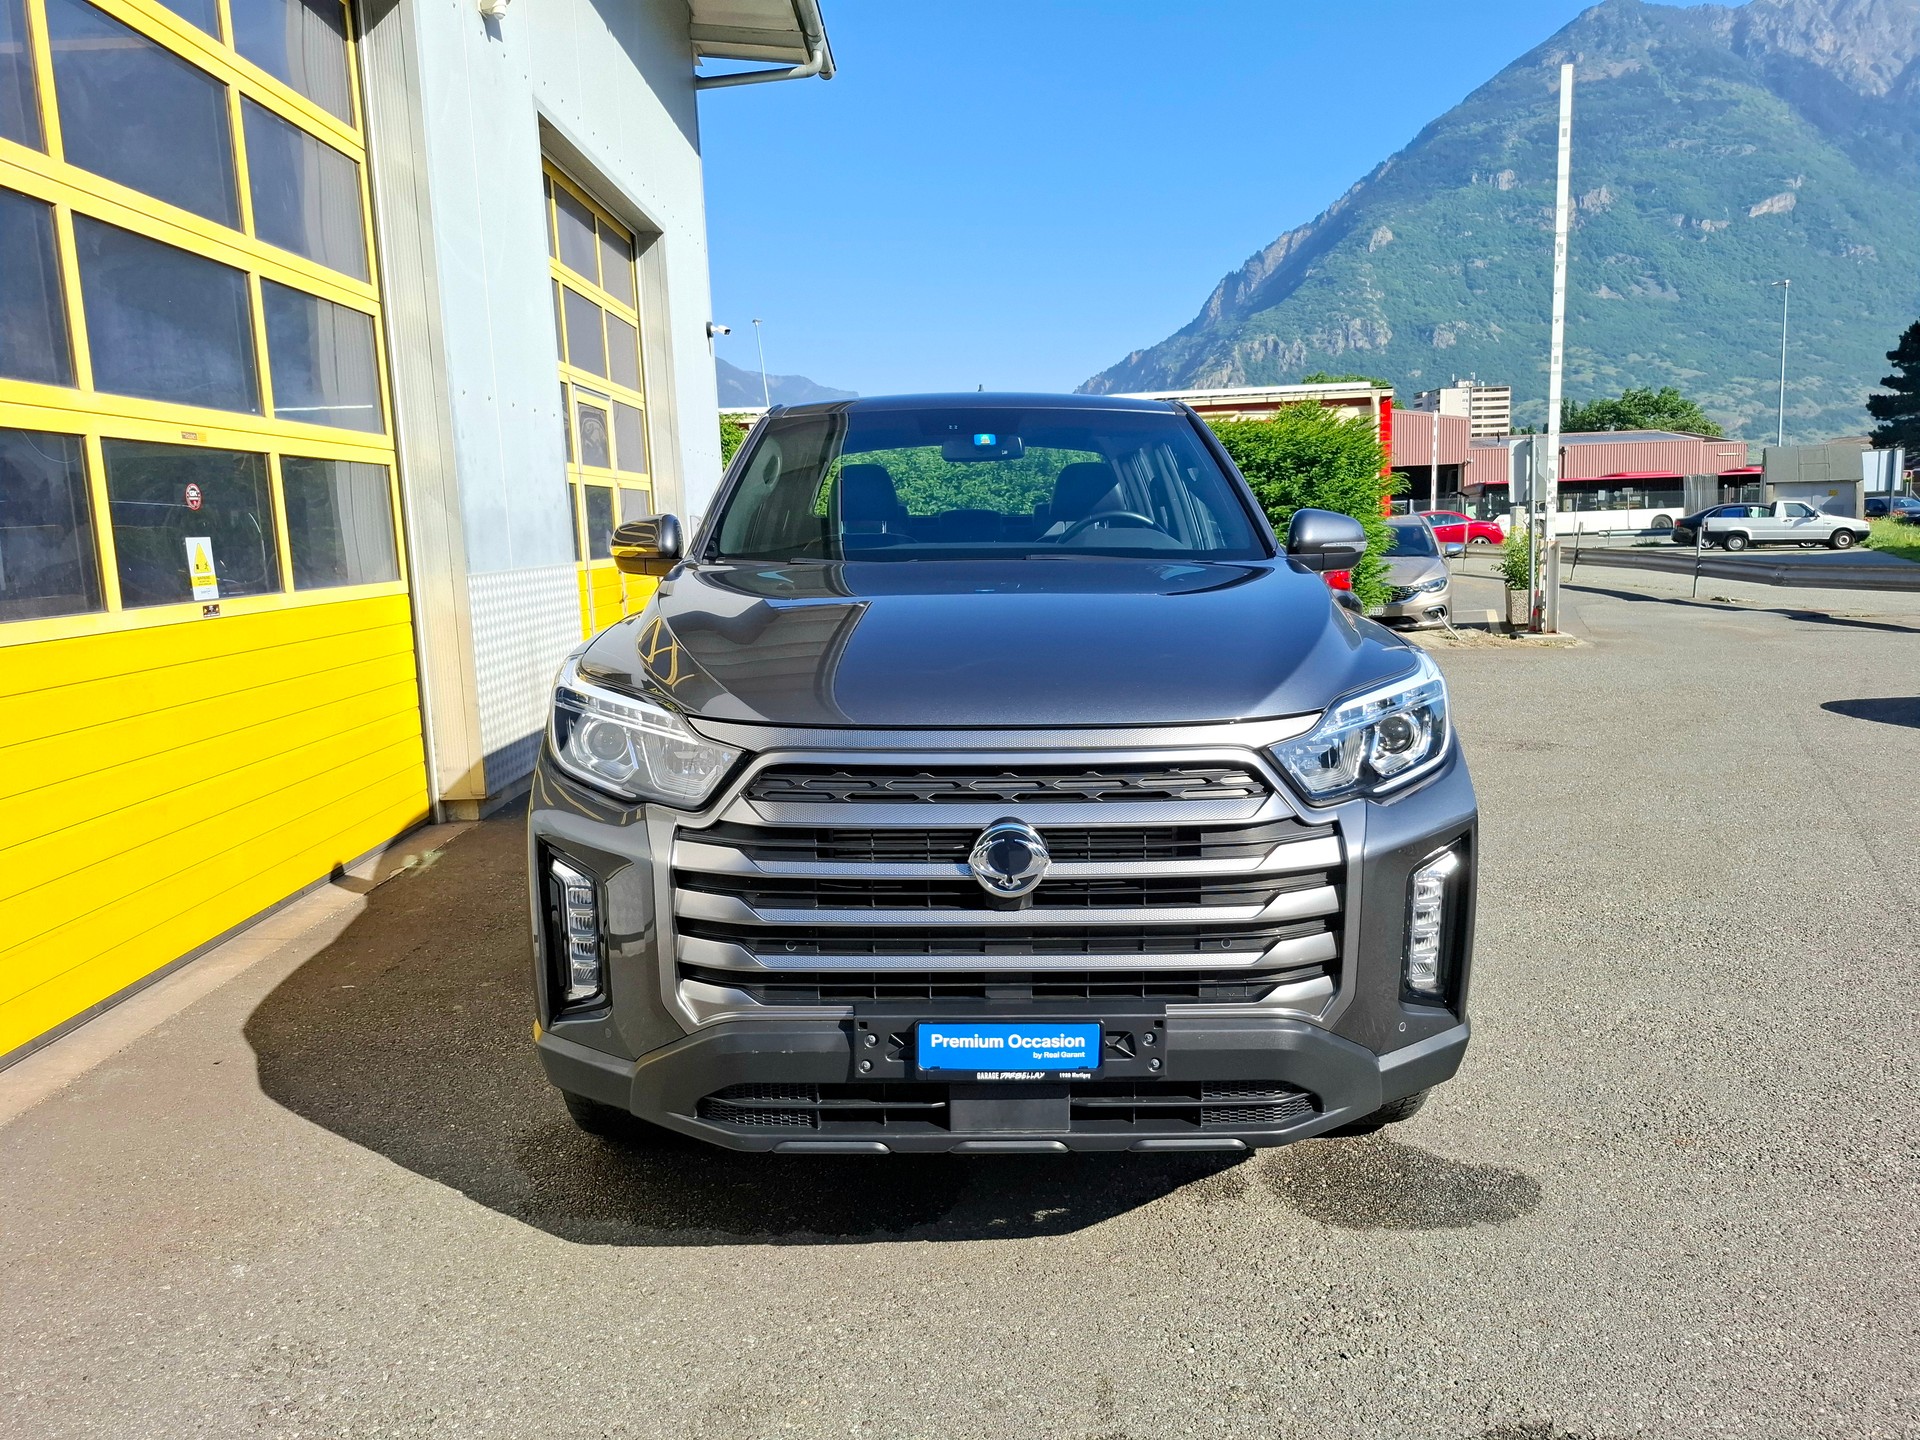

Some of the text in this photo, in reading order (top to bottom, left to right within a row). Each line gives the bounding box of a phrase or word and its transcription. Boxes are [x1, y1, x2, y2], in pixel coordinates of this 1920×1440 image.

[931, 1033, 1085, 1049] Premium Occasion
[1033, 1051, 1043, 1060] by
[1061, 1051, 1086, 1059] Garant
[977, 1072, 1000, 1080] GARAGE
